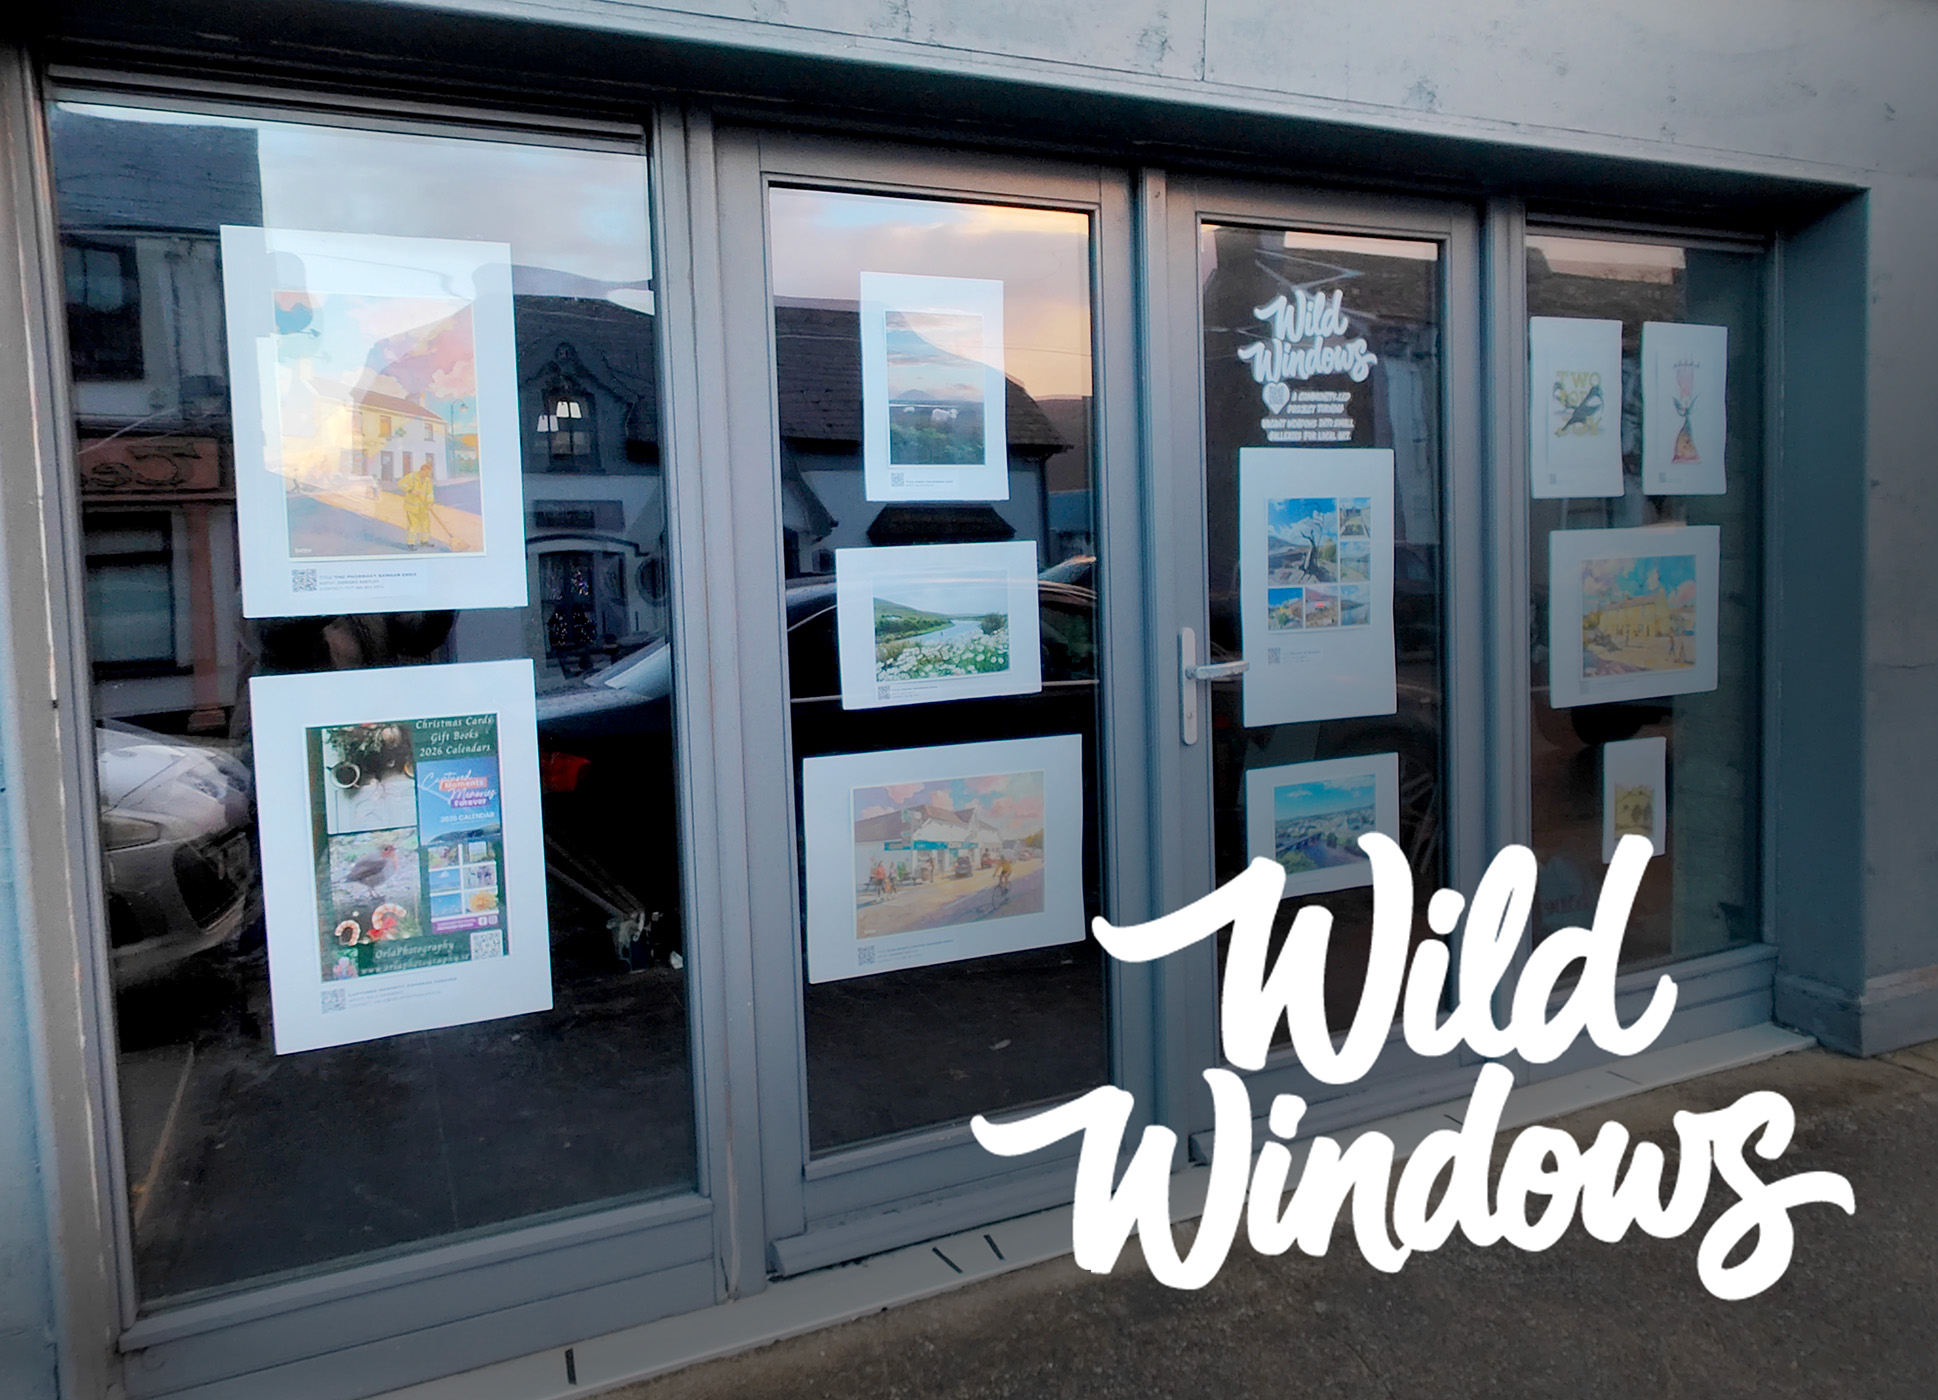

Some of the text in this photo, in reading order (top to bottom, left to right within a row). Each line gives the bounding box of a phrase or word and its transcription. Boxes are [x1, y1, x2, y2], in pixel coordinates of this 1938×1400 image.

[1253, 288, 1349, 343] Wild
[1237, 336, 1378, 383] Windows
[1556, 370, 1602, 389] TWO
[1303, 430, 1317, 441] FOR
[1317, 430, 1337, 441] LOCAL
[415, 715, 493, 730] Christmas Cards
[430, 729, 479, 745] Gift Books
[420, 743, 491, 757] 2026 Calendars
[444, 778, 485, 789] Moments
[454, 798, 487, 808] Forever
[458, 811, 495, 821] CALENDAR
[375, 940, 455, 960] OrlaPhotography
